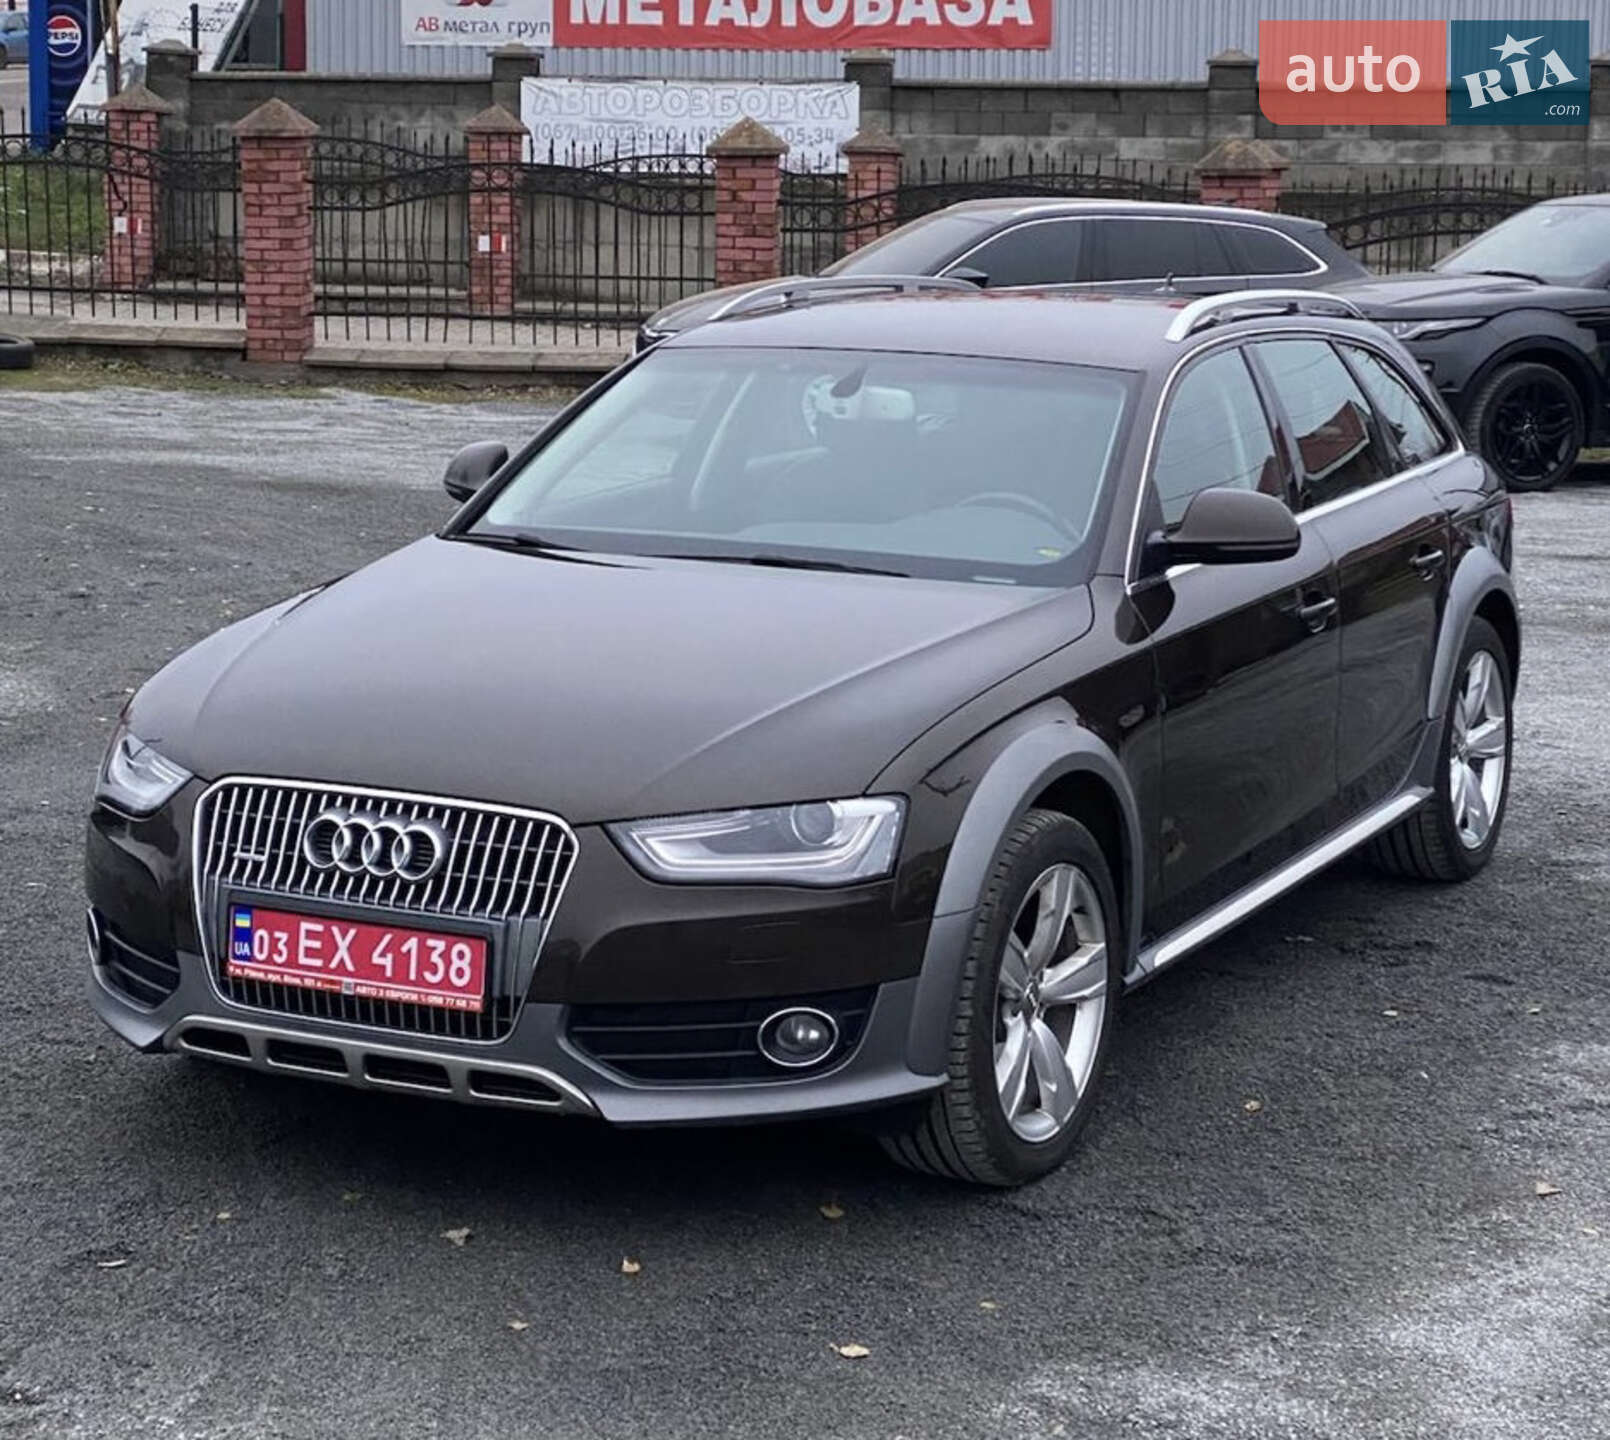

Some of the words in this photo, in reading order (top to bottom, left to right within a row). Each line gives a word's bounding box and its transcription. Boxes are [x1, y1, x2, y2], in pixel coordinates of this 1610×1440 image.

[443, 20, 500, 34] метал
[507, 20, 551, 38] груп
[532, 85, 849, 120] АВТОРОЗБОРКА
[235, 942, 250, 957] UA
[253, 928, 289, 964] 03
[298, 921, 358, 973] EX
[372, 934, 473, 988] 4138
